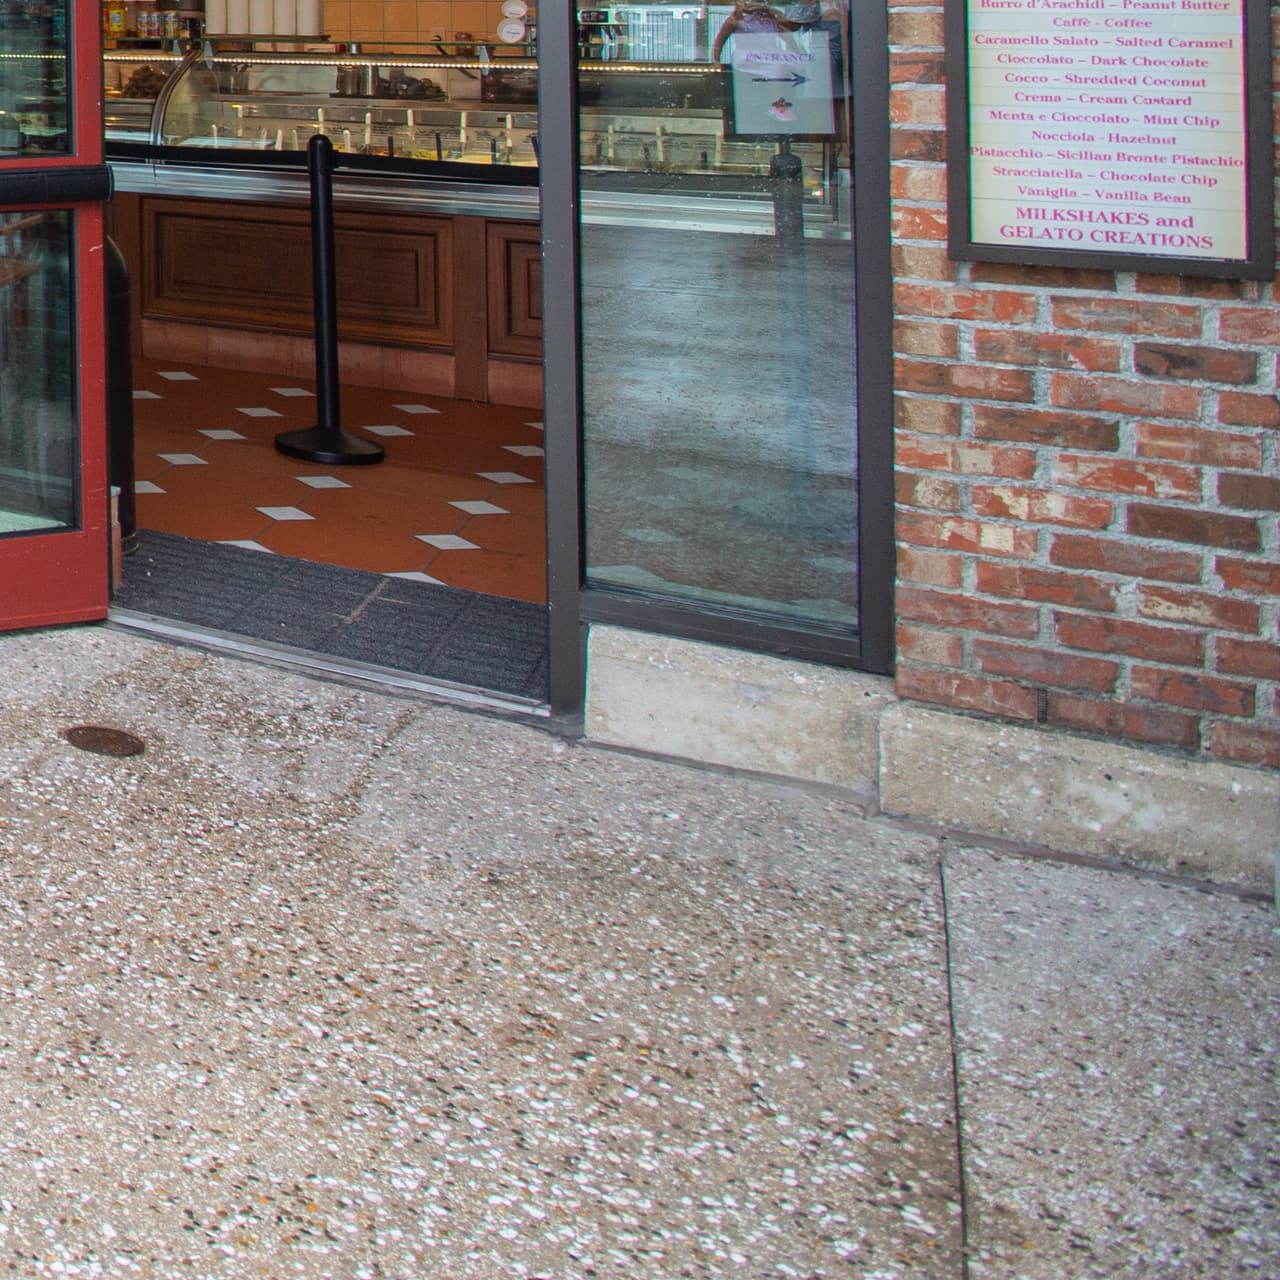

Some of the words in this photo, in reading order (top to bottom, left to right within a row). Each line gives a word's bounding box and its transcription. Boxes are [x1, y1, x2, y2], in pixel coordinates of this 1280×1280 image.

[980, 0, 1023, 9] Burro
[1122, 0, 1175, 10] Peanut
[1180, 0, 1229, 10] Butter
[1104, 18, 1153, 28] Coffee
[974, 35, 1048, 45] Caramello
[1053, 36, 1098, 46] Salato
[1115, 37, 1163, 47] Salted
[1167, 38, 1233, 48] Caramel
[995, 54, 1073, 64] Cioccolato
[1091, 55, 1126, 66] Dark
[1131, 57, 1208, 68] Chocolate
[1003, 73, 1049, 83] Cocco
[1064, 74, 1137, 86] Shredded
[1142, 76, 1206, 88] Coconut
[1014, 92, 1062, 103] Crema
[1077, 96, 1127, 105] Cream
[1132, 96, 1192, 106] Custard
[989, 110, 1034, 121] Menta
[1037, 113, 1046, 121] e
[1050, 112, 1129, 124] Cioccolato
[1143, 115, 1178, 125] Mint
[1182, 115, 1220, 128] Chip
[1032, 130, 1095, 142] Nocciola
[1108, 133, 1176, 145] Hazelnut
[970, 147, 1043, 159] Pistacchio
[1056, 150, 1112, 161] Sicilian
[1115, 152, 1167, 163] Bronte
[1171, 153, 1244, 167] Pistachio
[992, 167, 1083, 179] Stracciatella
[1098, 171, 1176, 183] Chocolate
[1181, 174, 1218, 187] Chip
[1017, 186, 1077, 199] Vaniglia
[1093, 189, 1148, 202] Vanilla
[1152, 192, 1191, 204] Bean
[1016, 208, 1149, 226] MILKSHAKES
[1155, 214, 1194, 228] and
[999, 224, 1083, 240] GELATO
[1089, 229, 1213, 248] CREATIONS
